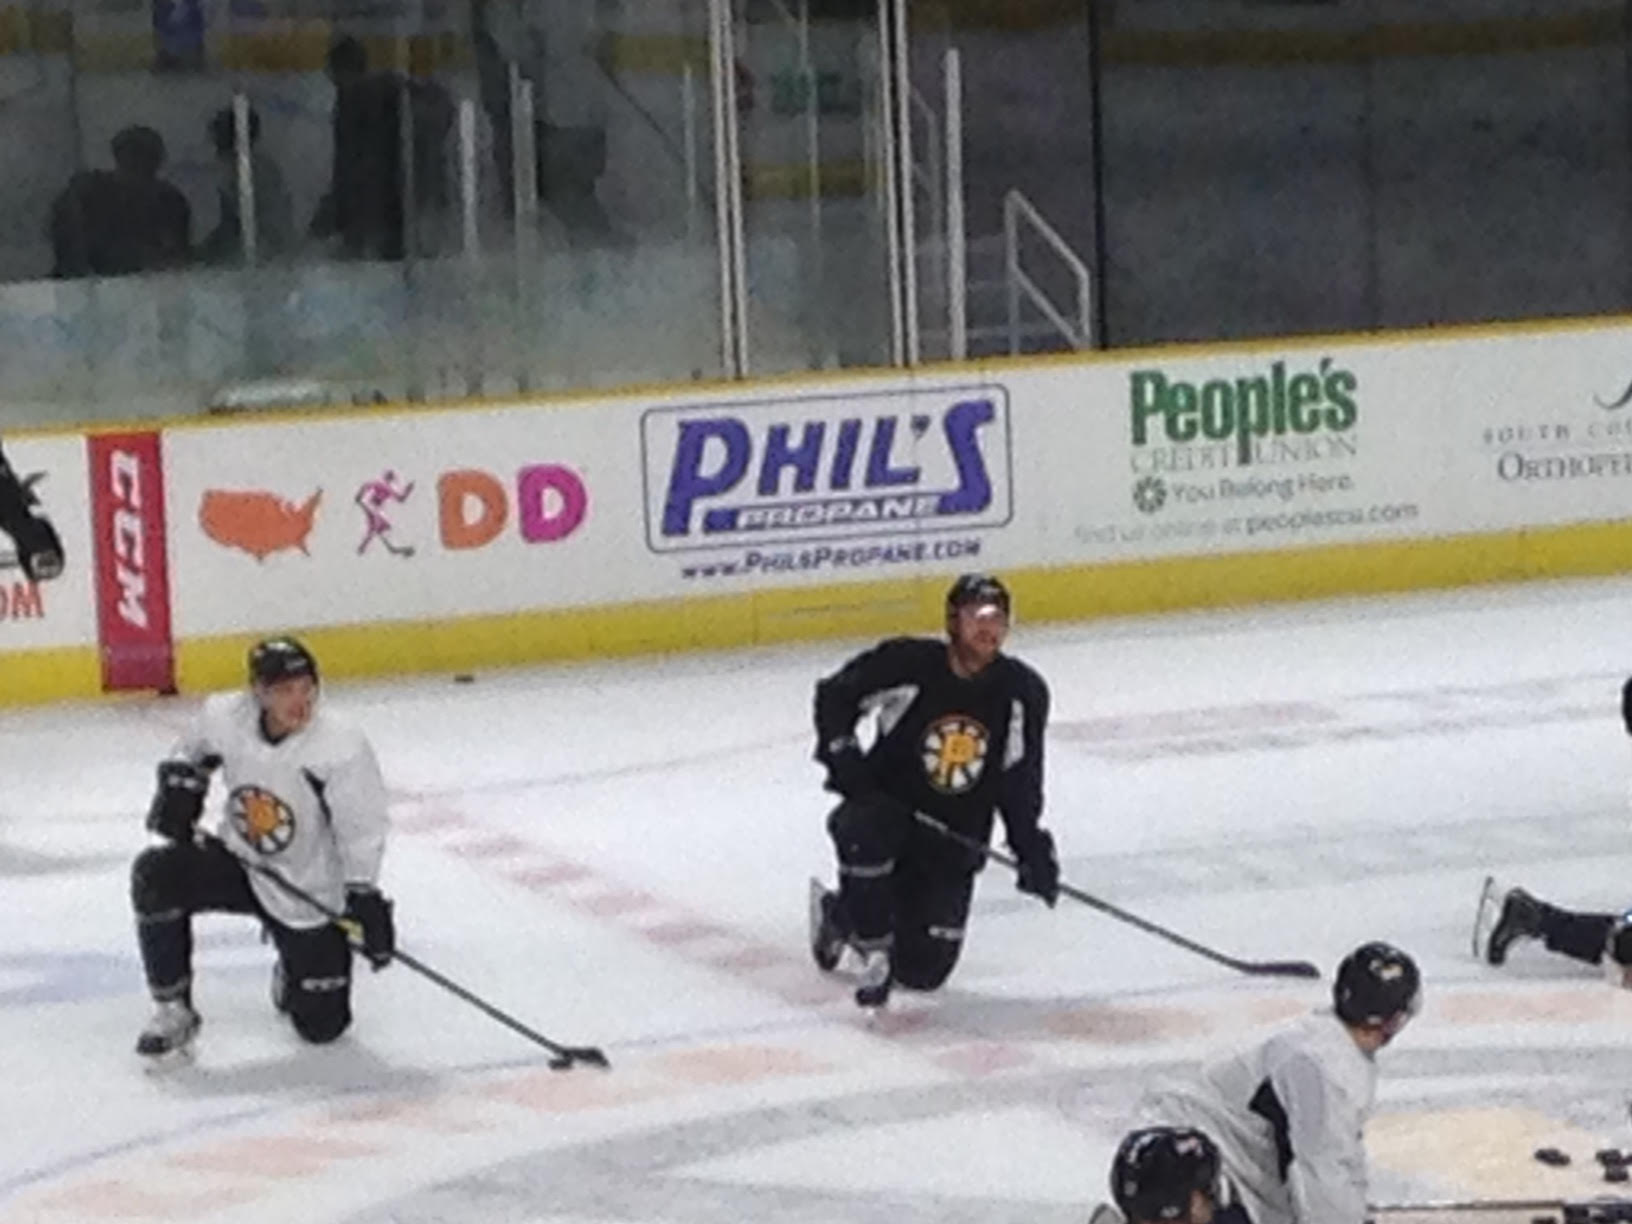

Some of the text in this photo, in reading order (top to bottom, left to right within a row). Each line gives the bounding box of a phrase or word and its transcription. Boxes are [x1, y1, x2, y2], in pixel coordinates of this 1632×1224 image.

[1130, 357, 1359, 467] People's
[1483, 425, 1572, 445] SOUTH
[661, 398, 996, 537] PHIL'S
[1130, 436, 1358, 474] CREDIT UNION
[1170, 486, 1215, 504] You
[1220, 476, 1295, 502] Belong
[737, 493, 940, 530] PROPANE
[110, 448, 149, 629] CCM
